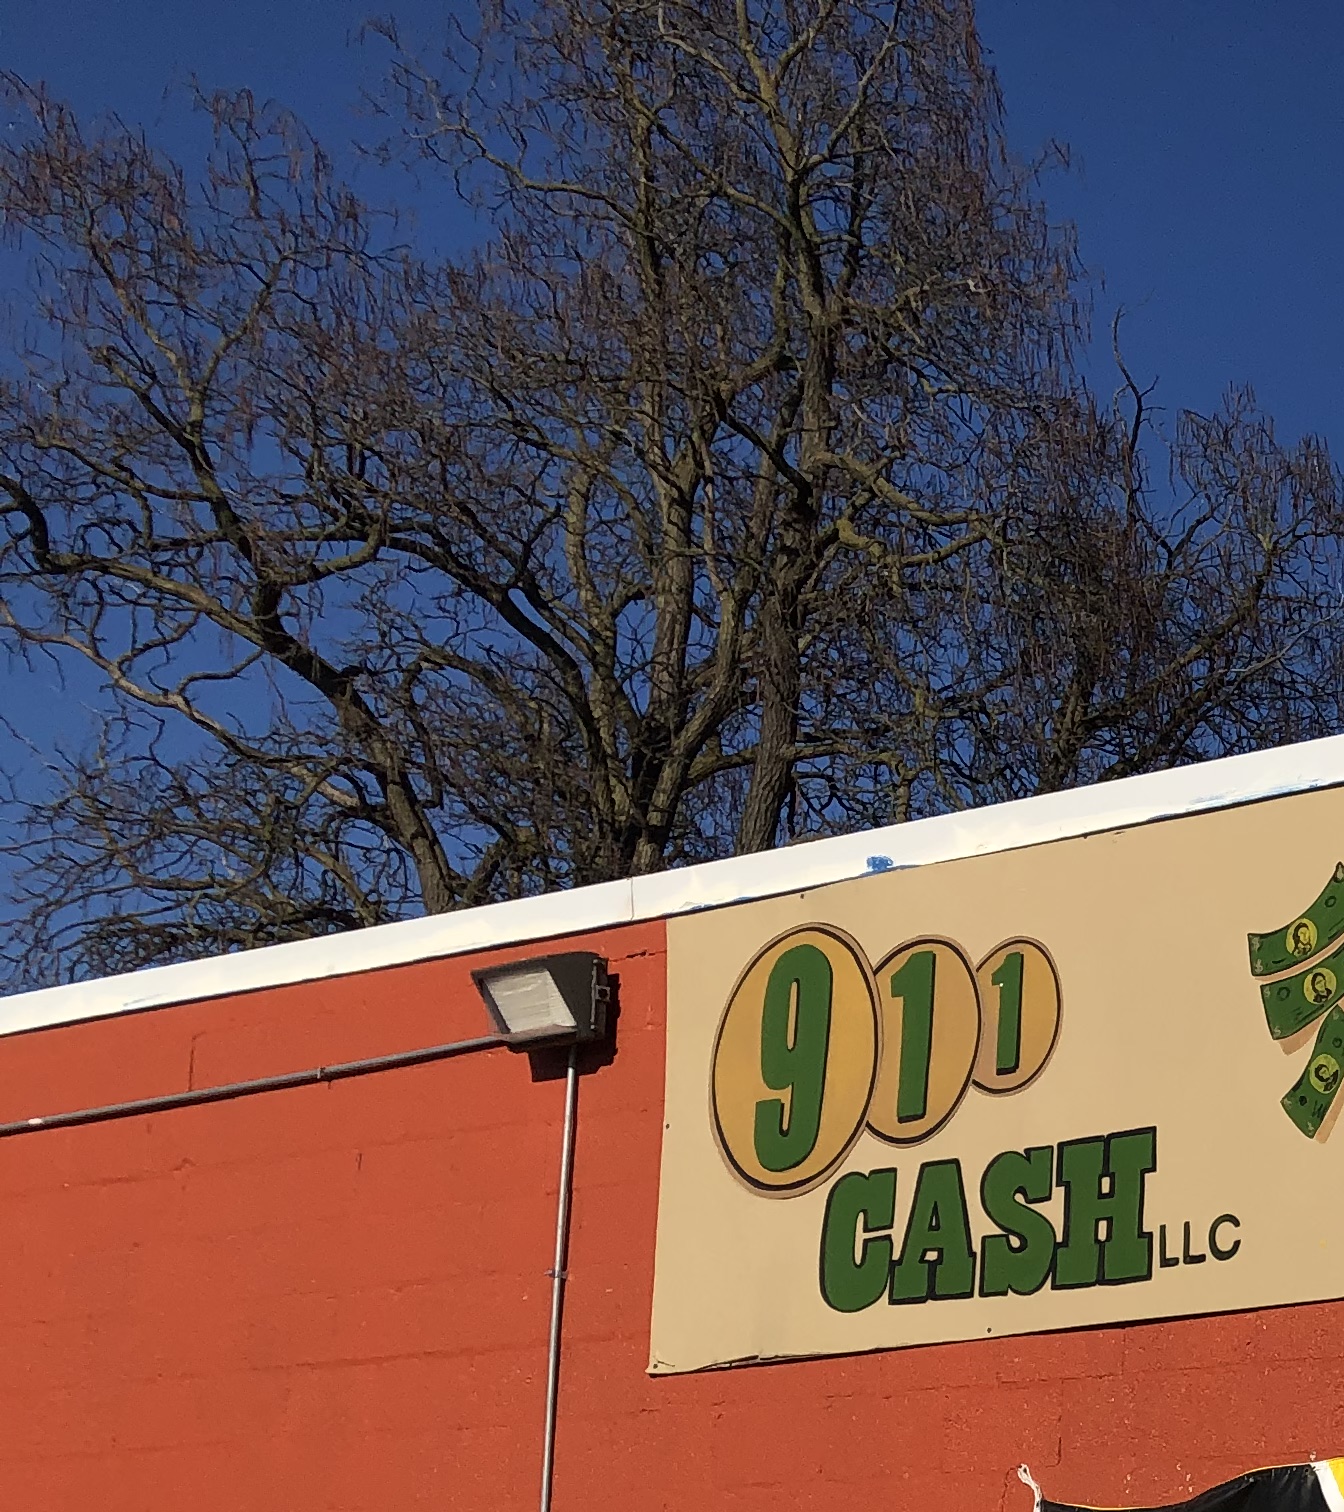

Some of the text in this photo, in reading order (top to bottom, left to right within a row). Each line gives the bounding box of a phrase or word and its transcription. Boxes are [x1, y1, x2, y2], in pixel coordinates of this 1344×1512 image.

[754, 944, 1023, 1172] 911
[820, 1126, 1241, 1313] CASH LLC
